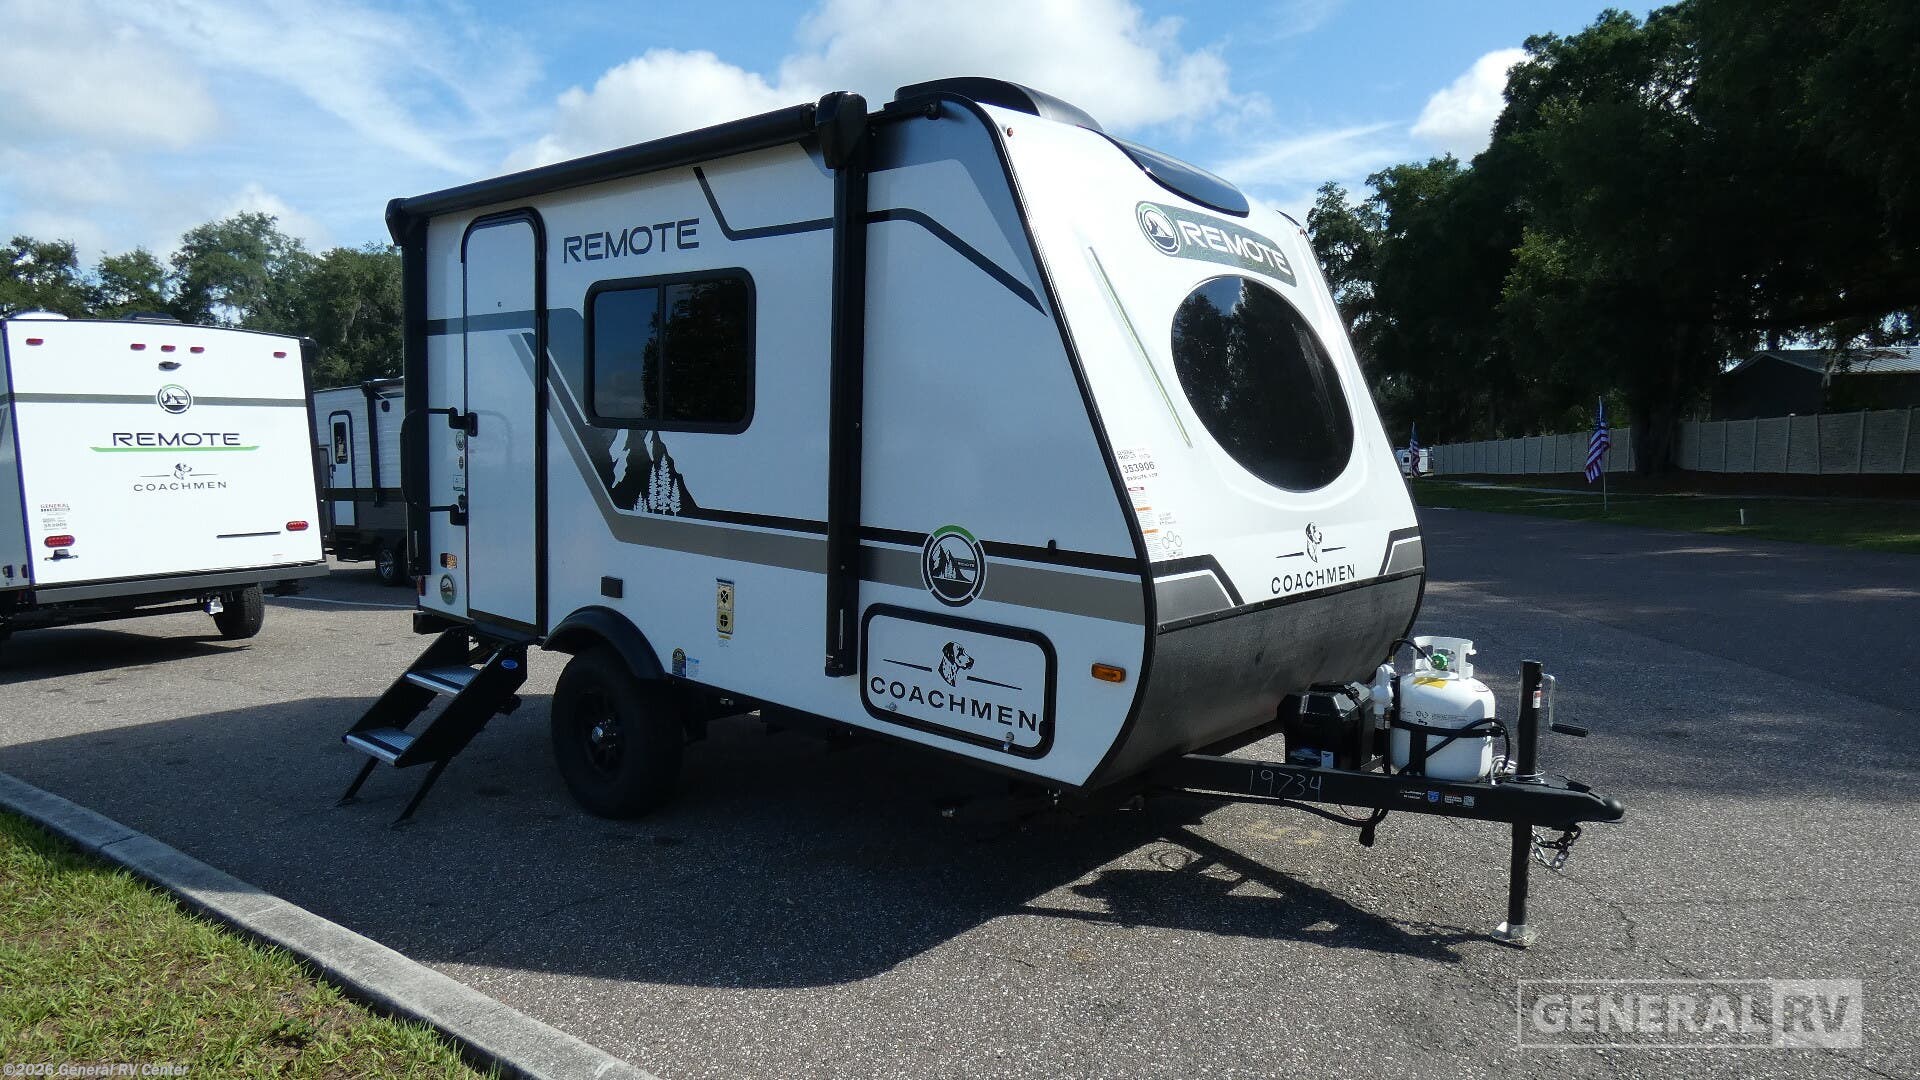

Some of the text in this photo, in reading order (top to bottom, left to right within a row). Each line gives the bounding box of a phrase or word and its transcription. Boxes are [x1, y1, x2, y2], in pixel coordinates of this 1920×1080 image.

[563, 217, 700, 264] REMOTE
[1176, 219, 1293, 276] REMOTE
[112, 432, 241, 446] REMOTE
[1122, 461, 1155, 474] 353906
[133, 481, 227, 492] COACHMEN
[1271, 564, 1356, 594] COACHMEN
[870, 676, 1039, 732] COACHMEN
[1249, 768, 1322, 801] 19734
